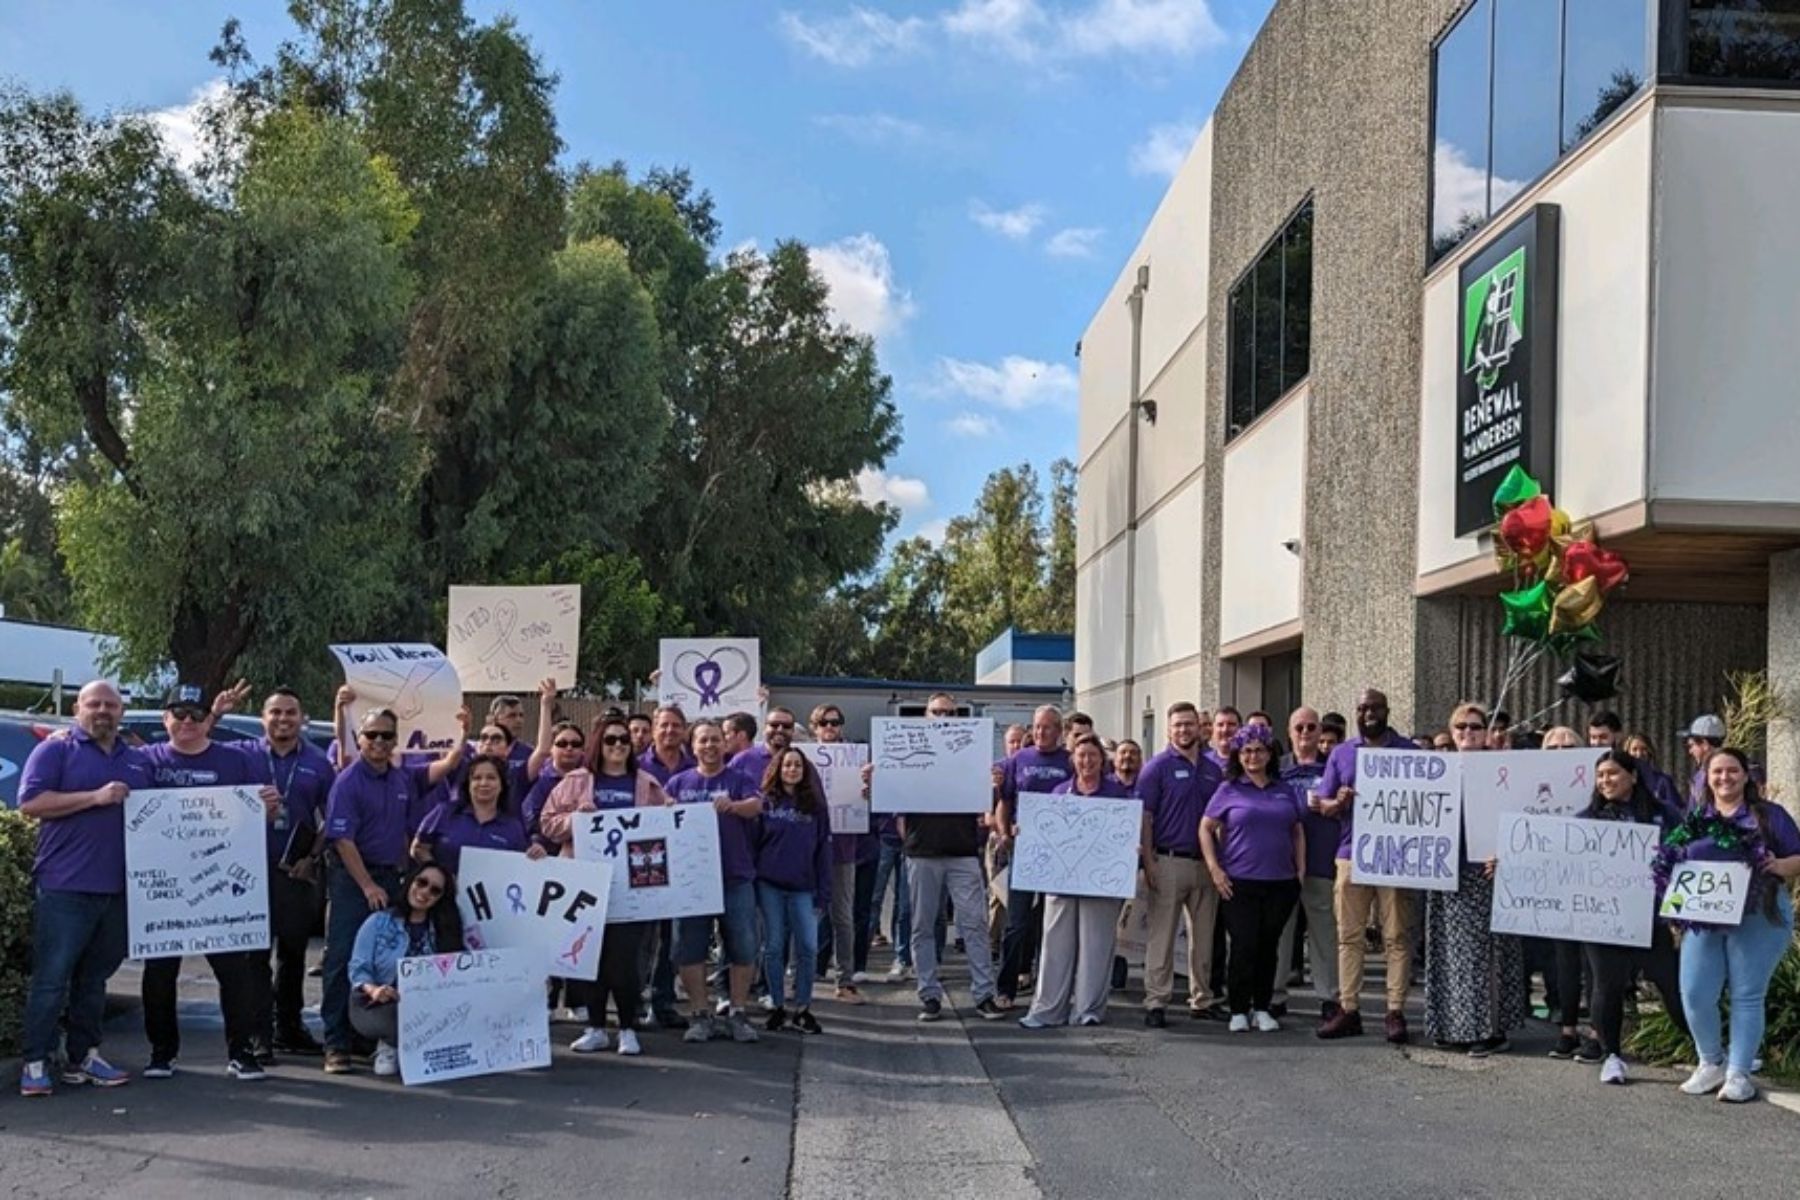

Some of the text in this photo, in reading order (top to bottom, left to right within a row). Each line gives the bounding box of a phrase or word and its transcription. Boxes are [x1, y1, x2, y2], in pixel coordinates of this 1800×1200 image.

[1463, 381, 1522, 436] RENEWAL
[1471, 412, 1522, 457] ANDERSEN
[1364, 754, 1446, 780] UNITED
[1356, 833, 1453, 879] CANCER
[1673, 870, 1733, 896] RBA
